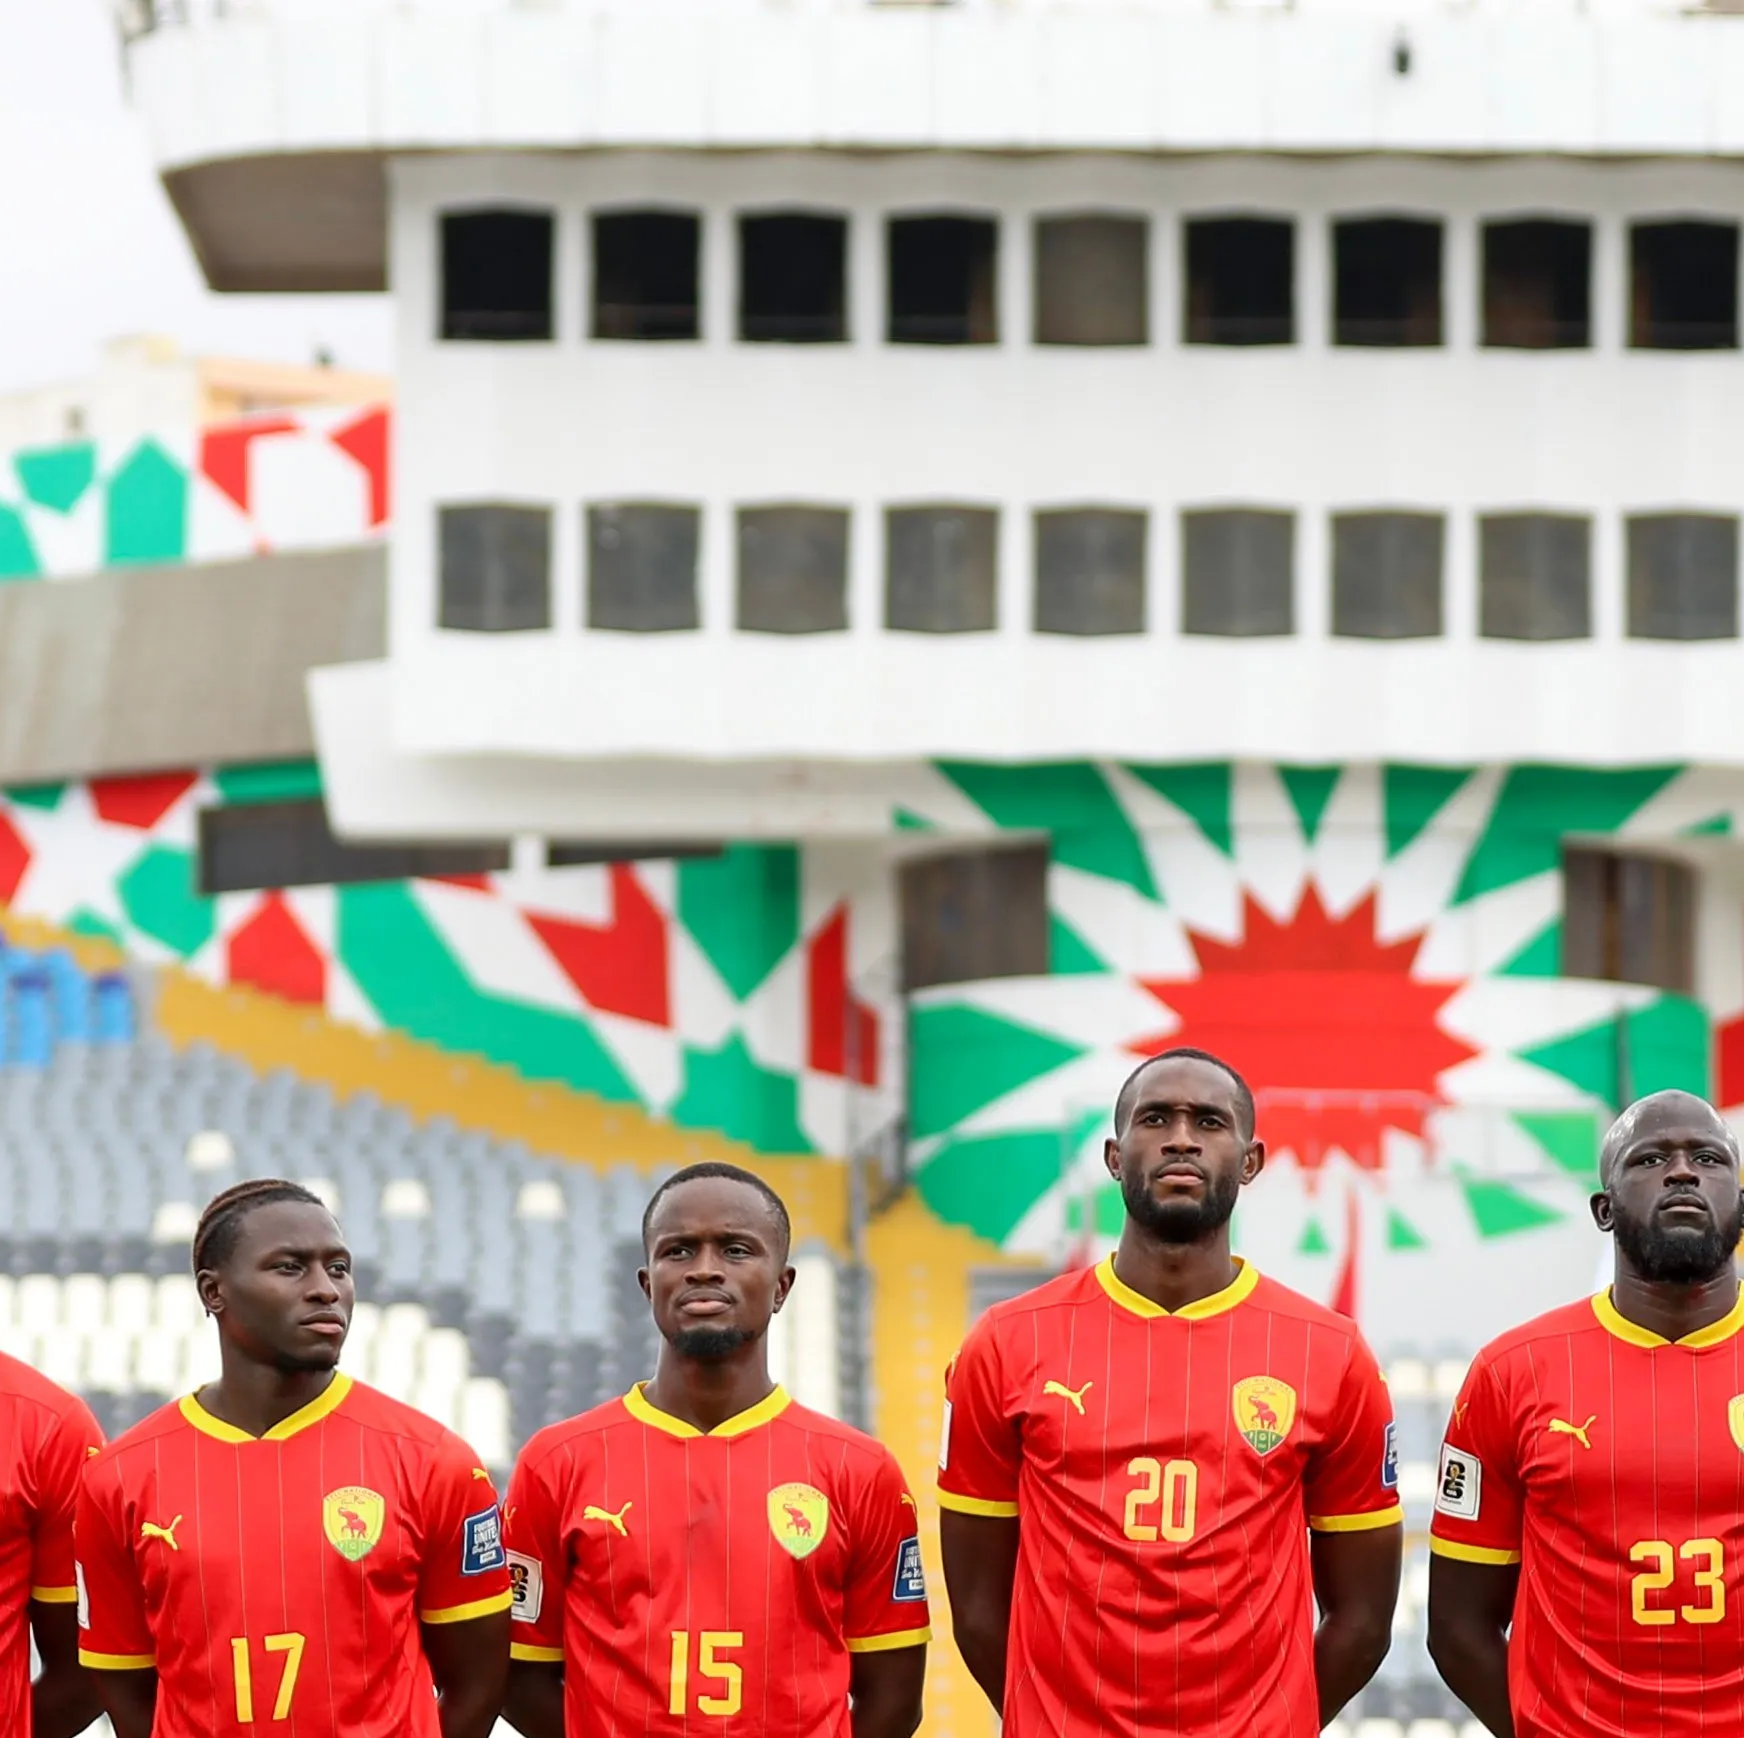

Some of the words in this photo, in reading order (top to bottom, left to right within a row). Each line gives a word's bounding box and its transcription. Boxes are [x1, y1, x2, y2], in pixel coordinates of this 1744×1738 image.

[1123, 1457, 1198, 1543] 20
[1629, 1538, 1725, 1625] 23
[231, 1632, 305, 1723] 17
[669, 1630, 743, 1716] 15
